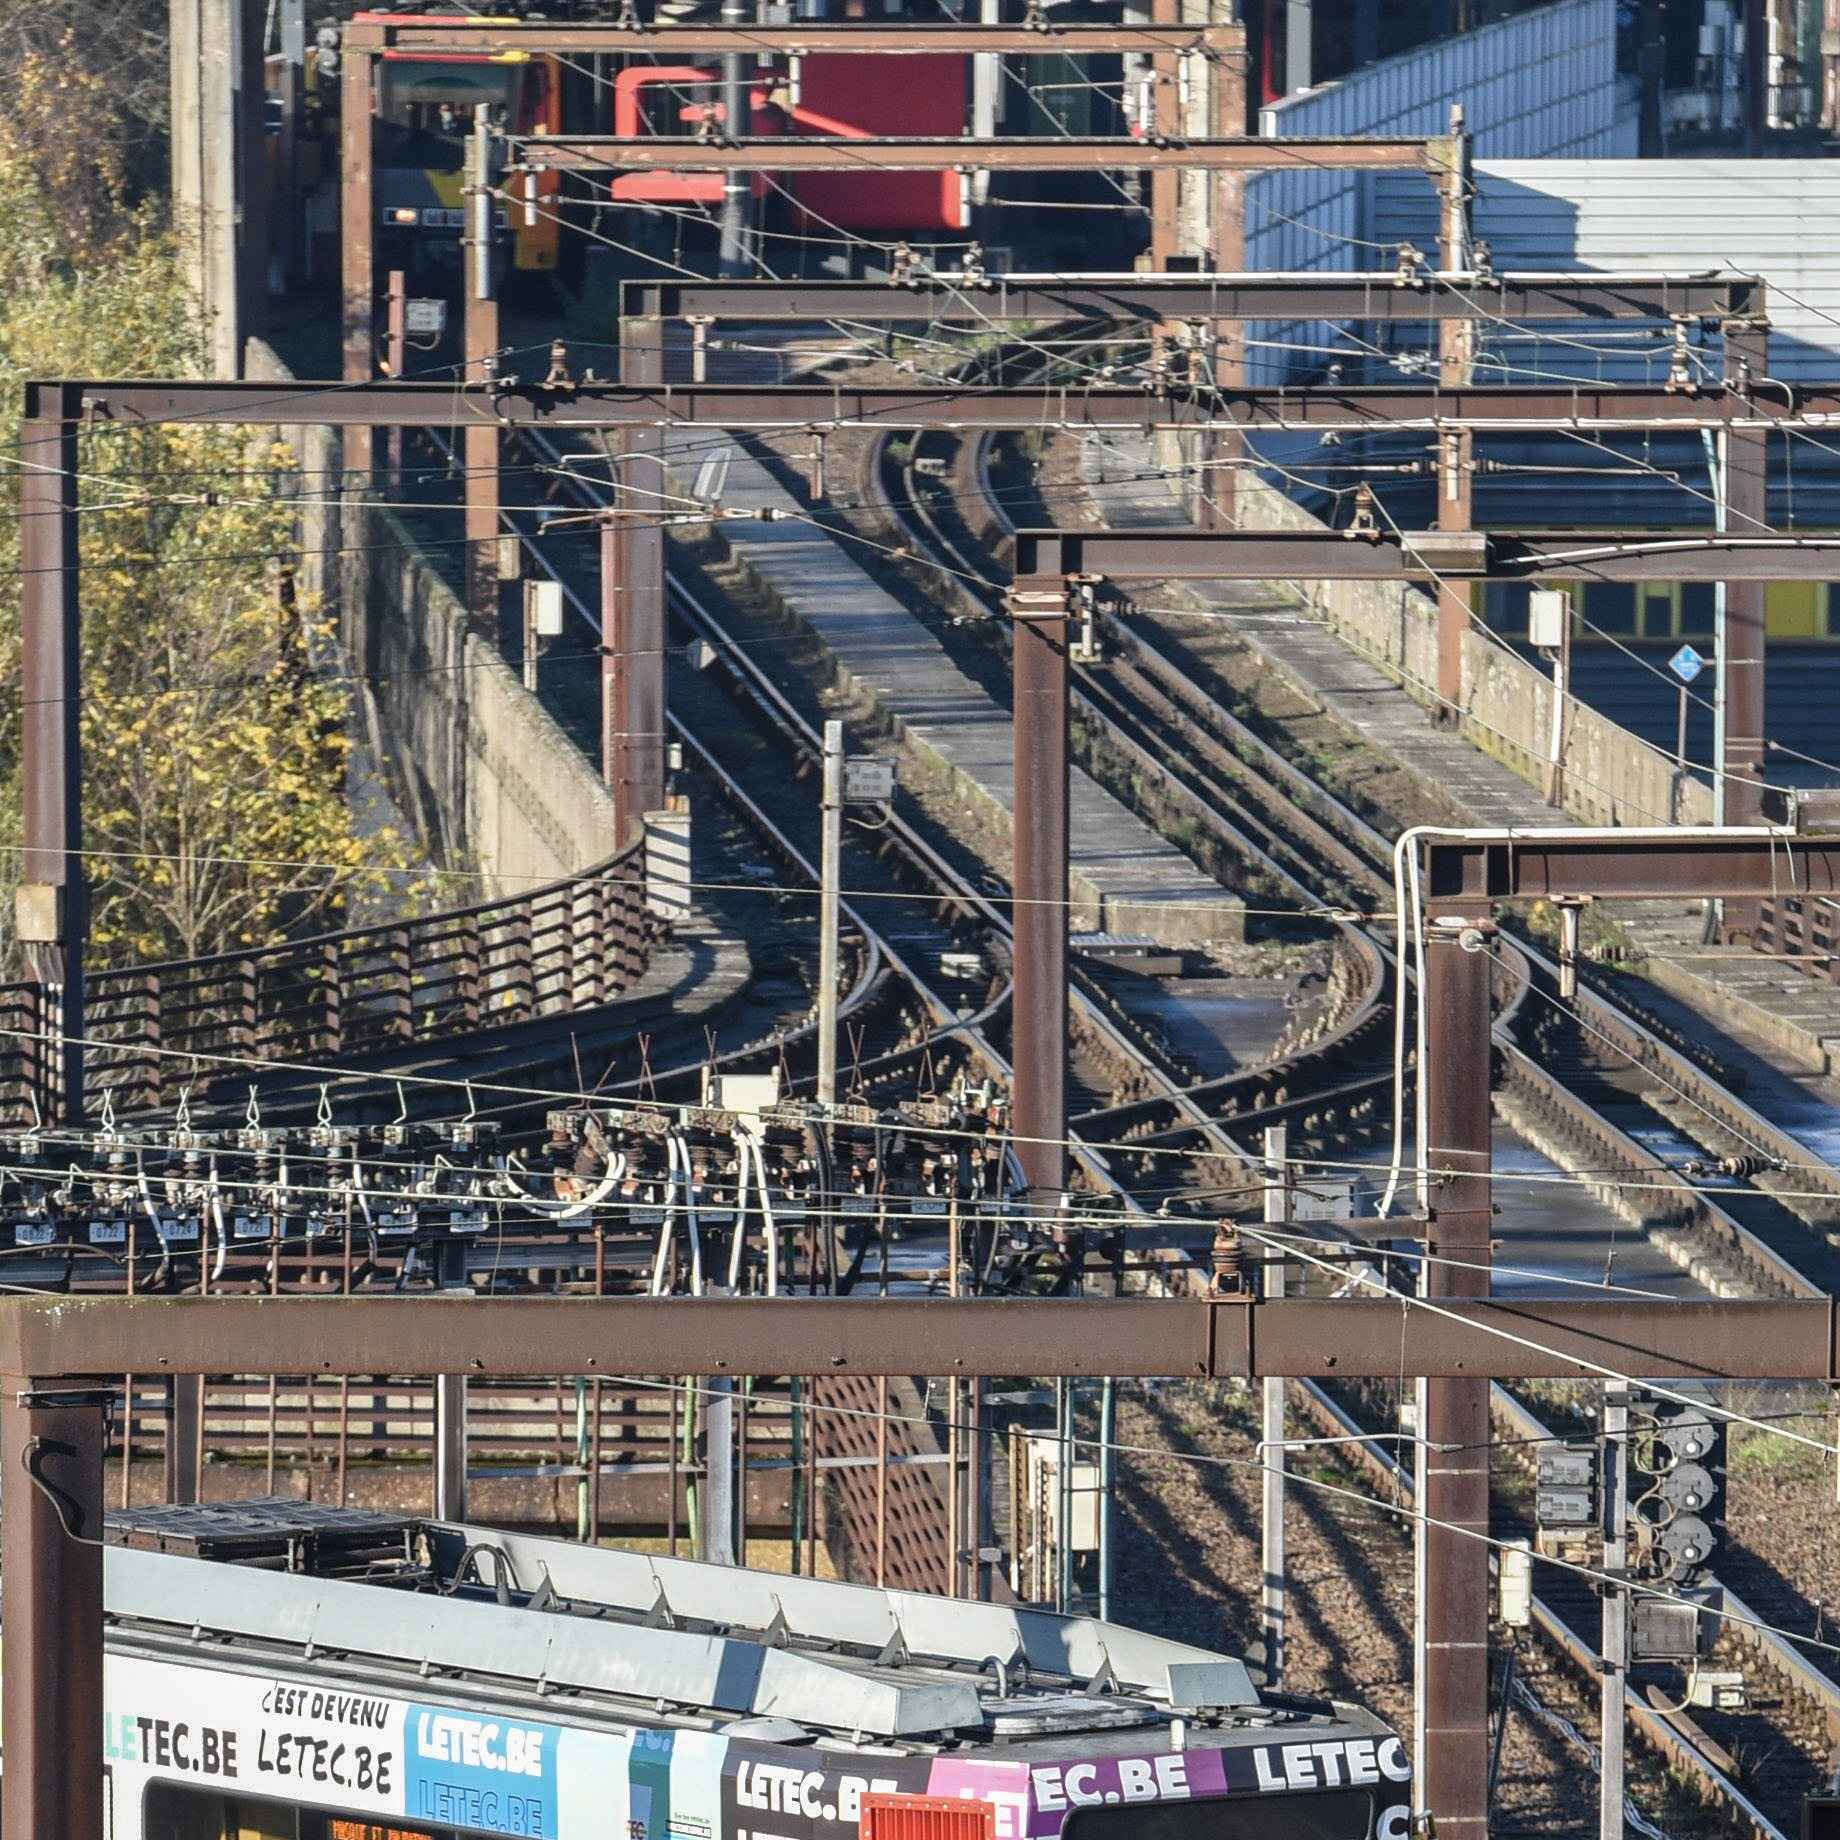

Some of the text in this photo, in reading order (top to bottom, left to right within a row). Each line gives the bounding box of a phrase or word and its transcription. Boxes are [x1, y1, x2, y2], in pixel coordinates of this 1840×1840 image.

[311, 1692, 389, 1729] DEVENU
[106, 1712, 238, 1778] LETEC.BE
[258, 1729, 393, 1794] LETEC.BE
[418, 1712, 544, 1777] LETEC.BE
[1254, 1737, 1412, 1792] LETEC
[418, 1779, 544, 1839] LETEC.BE
[1031, 1755, 1191, 1813] EC.BE
